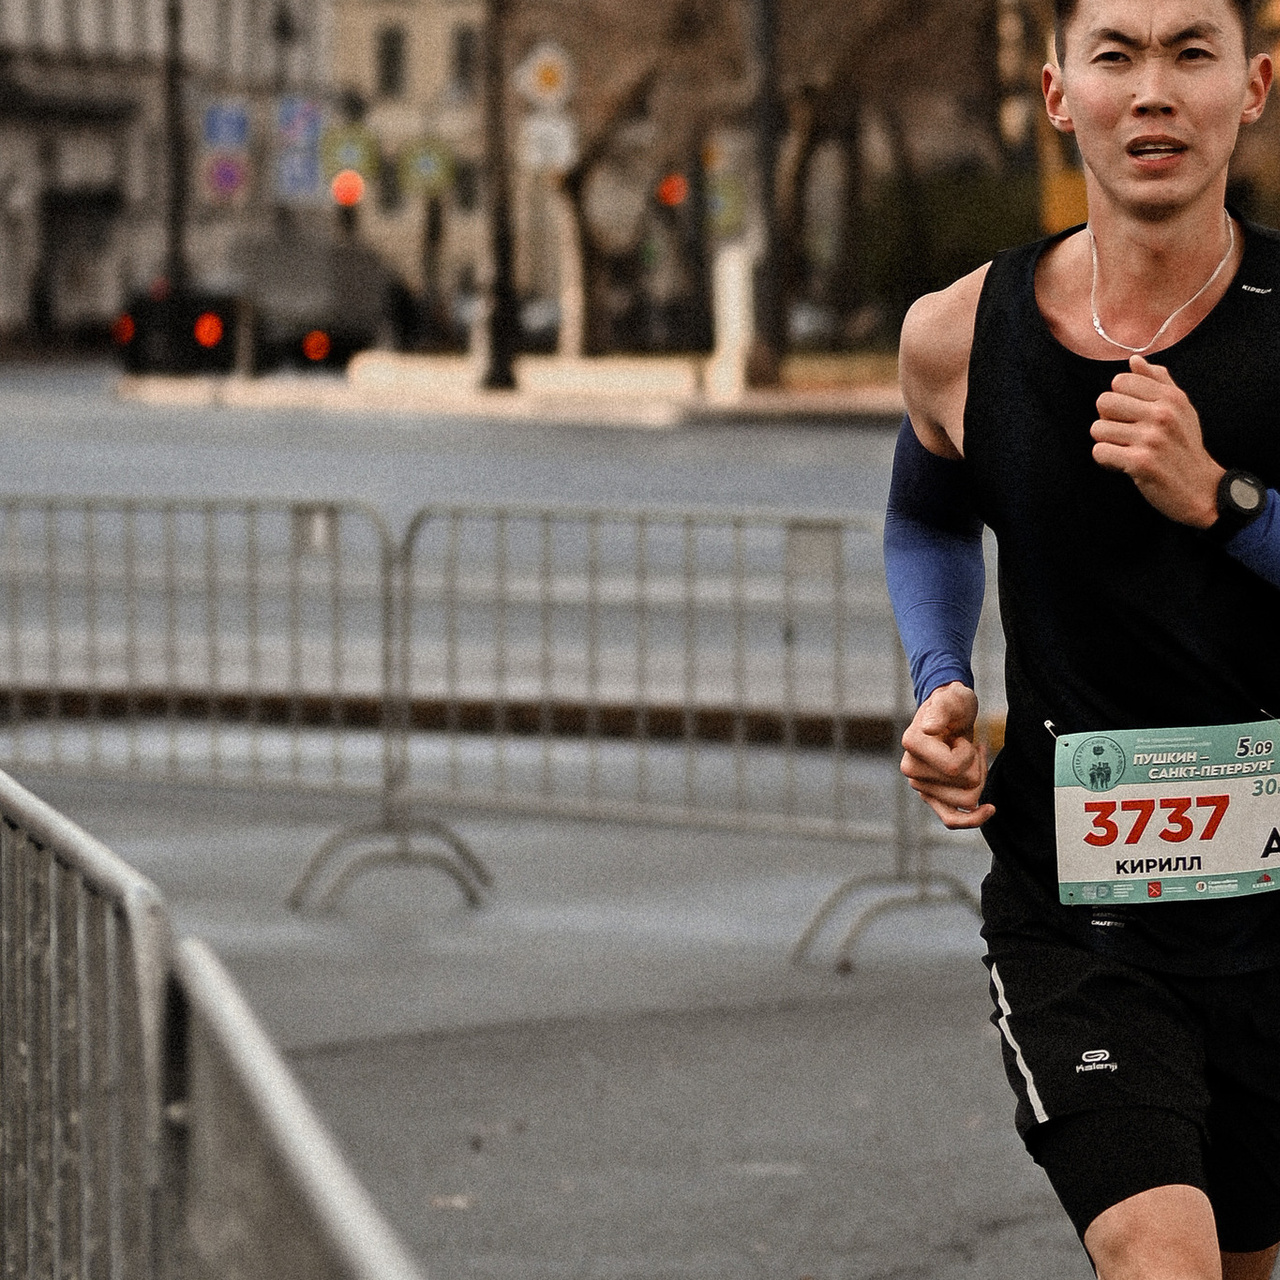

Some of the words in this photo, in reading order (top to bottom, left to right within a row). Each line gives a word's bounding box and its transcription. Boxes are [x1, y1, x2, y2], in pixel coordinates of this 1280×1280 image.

[1235, 736, 1273, 758] 5.09
[1133, 751, 1197, 766] ПУШКИН
[1148, 760, 1275, 780] САНКТ-ПЕТЕРБУРГ
[1083, 794, 1231, 848] 3737
[1115, 856, 1202, 875] КИРИЛЛ
